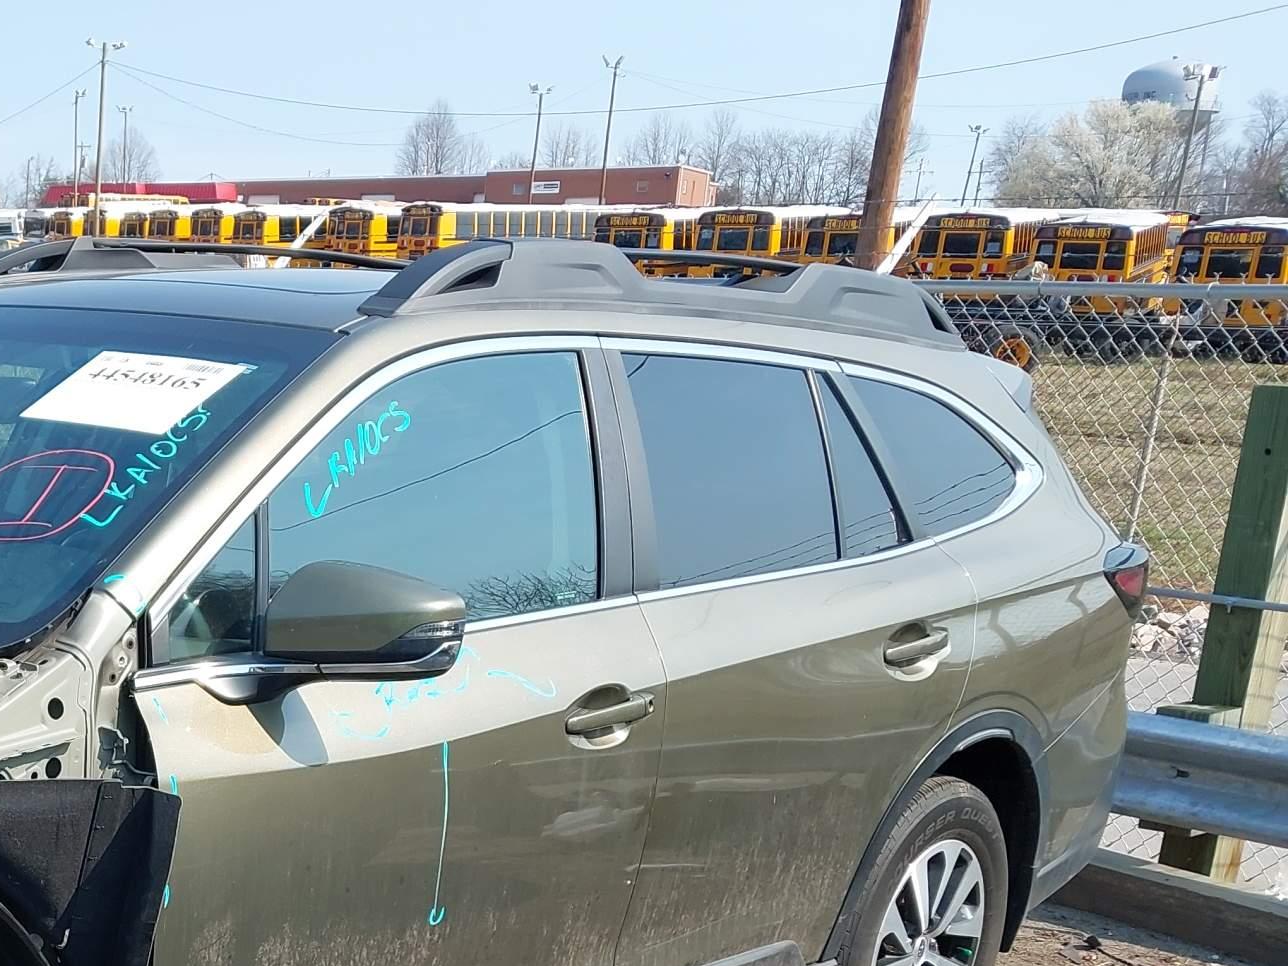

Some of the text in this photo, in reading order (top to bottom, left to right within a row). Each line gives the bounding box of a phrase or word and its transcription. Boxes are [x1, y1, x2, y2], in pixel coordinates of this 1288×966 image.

[1206, 232, 1265, 243] SCHOOL BUS
[88, 367, 207, 390] 44548165
